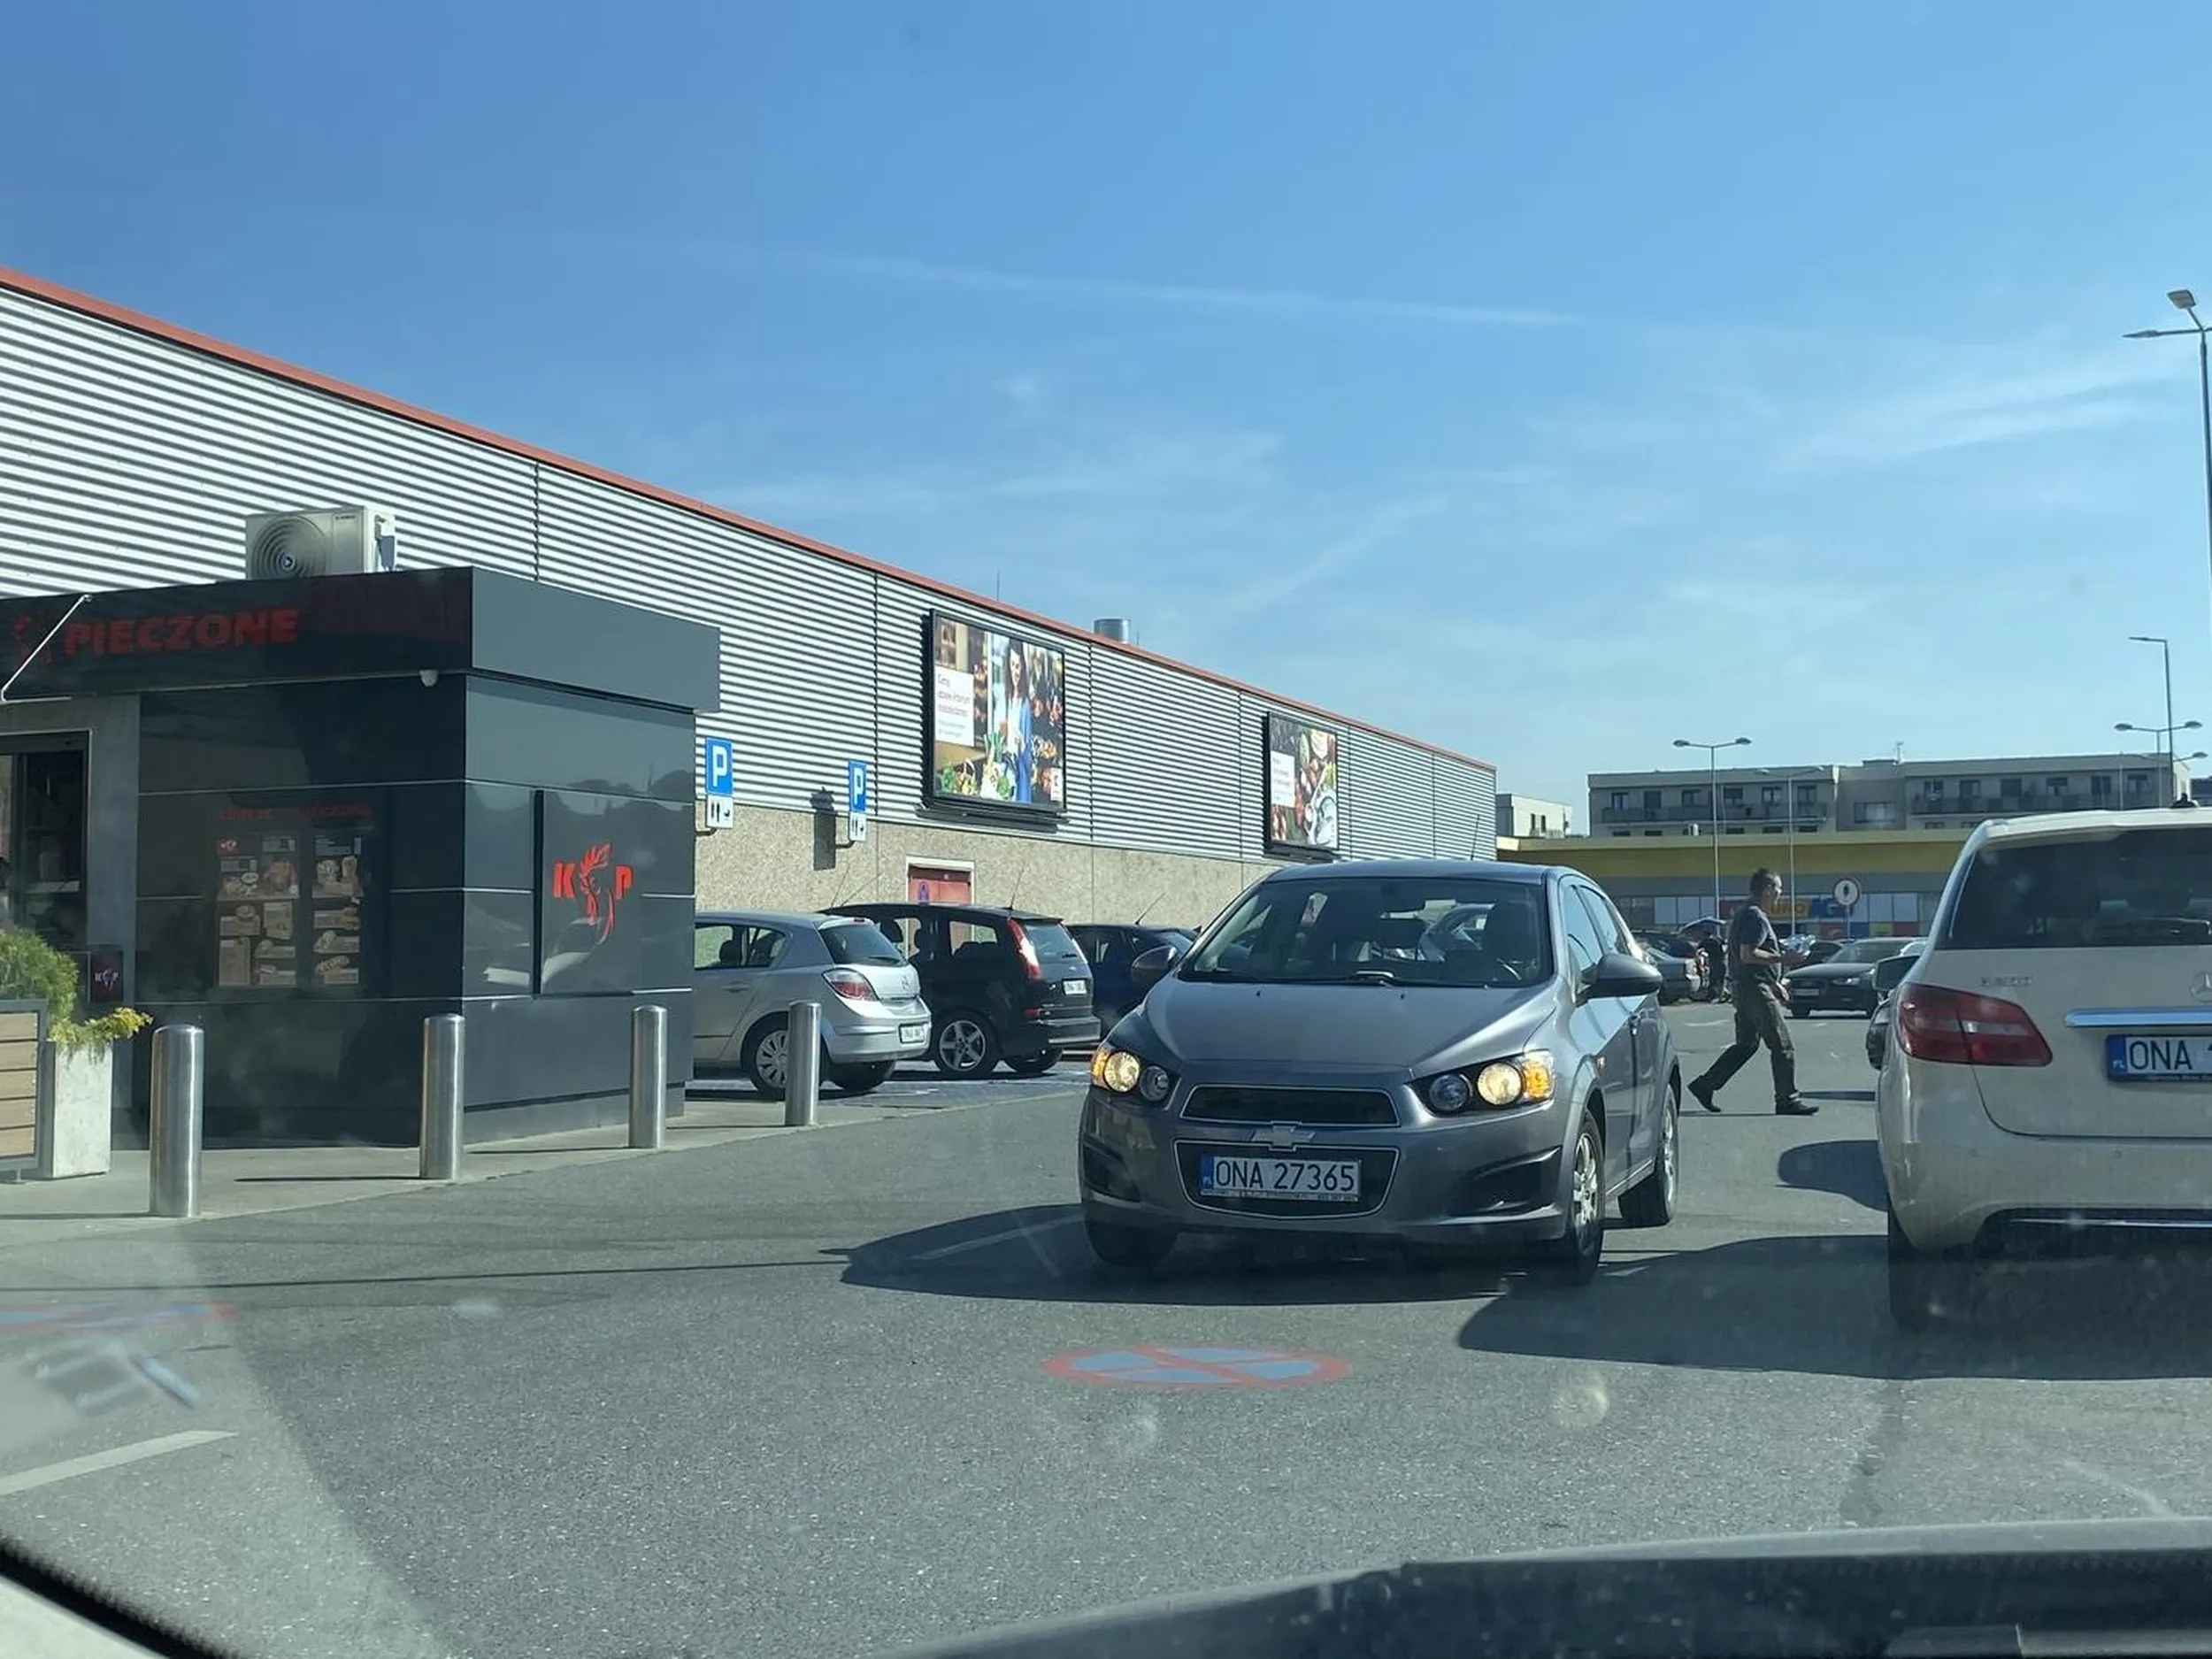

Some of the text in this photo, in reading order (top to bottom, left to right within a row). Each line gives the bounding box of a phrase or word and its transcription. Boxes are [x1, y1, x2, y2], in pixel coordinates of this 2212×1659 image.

[65, 608, 299, 657] PIECZONE
[711, 745, 728, 788] P
[853, 766, 864, 805] P
[2129, 1040, 2193, 1071] ONA
[1215, 1160, 1355, 1192] ONA 27365
